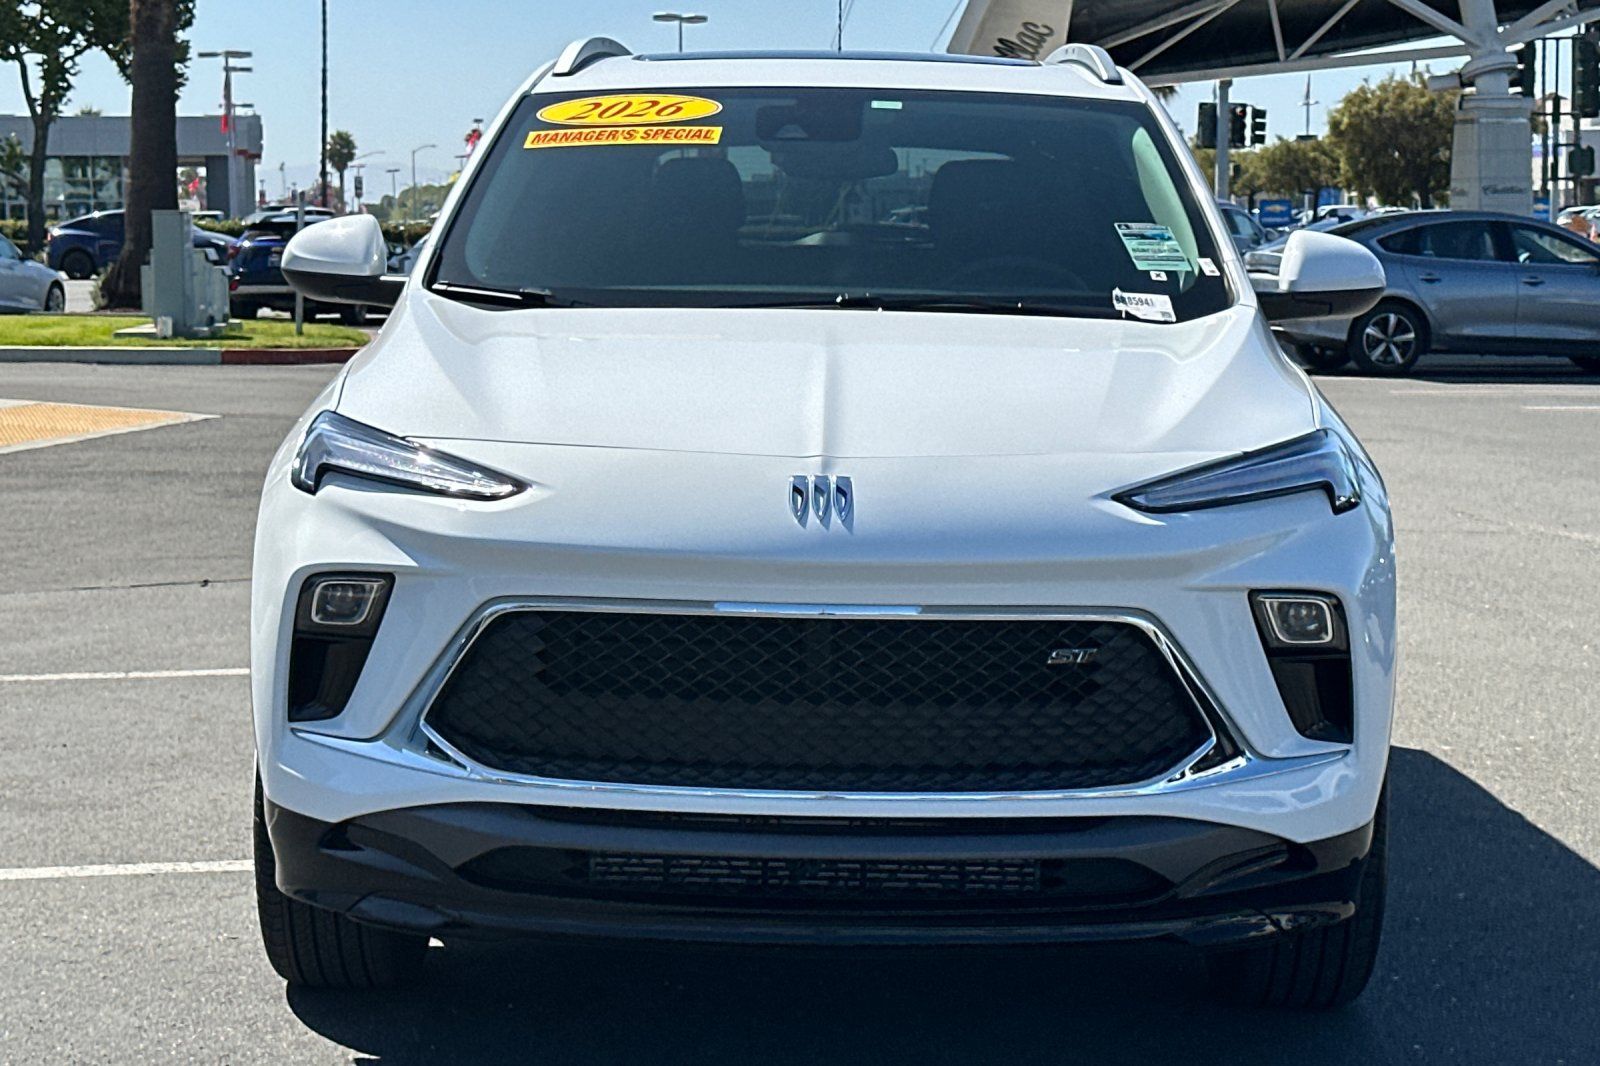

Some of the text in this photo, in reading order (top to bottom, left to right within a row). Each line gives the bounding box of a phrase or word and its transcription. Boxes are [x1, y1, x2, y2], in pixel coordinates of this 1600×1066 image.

[564, 99, 691, 120] 2026
[530, 127, 714, 145] MANAGER'S SPECIAL
[1047, 648, 1098, 664] ST
